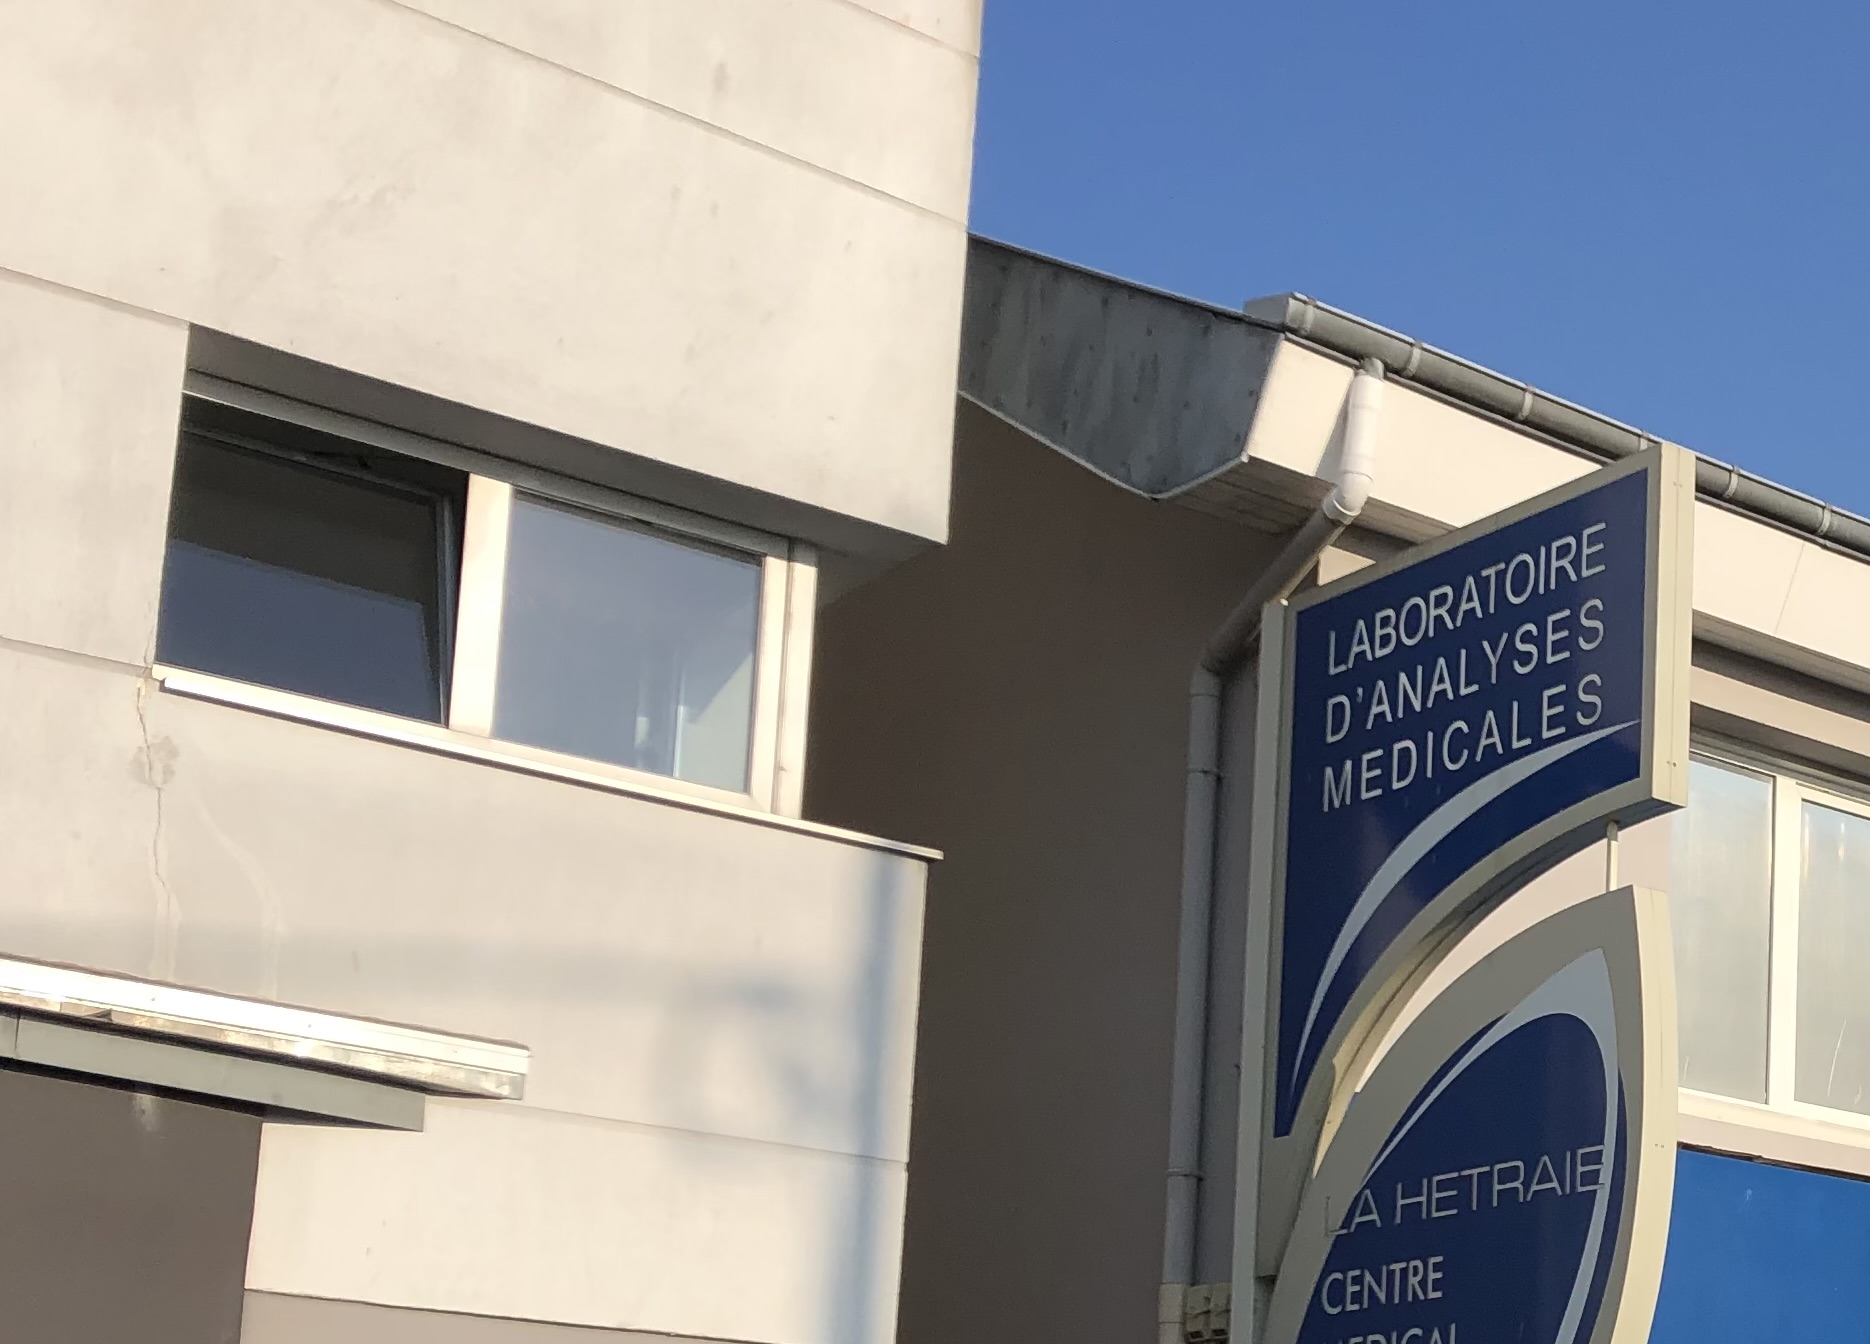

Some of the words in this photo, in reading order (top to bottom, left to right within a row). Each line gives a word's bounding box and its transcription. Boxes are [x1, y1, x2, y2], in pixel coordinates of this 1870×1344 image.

[1327, 523, 1606, 676] LABORATOIRE
[1325, 599, 1604, 744] D'ANALYSES
[1322, 674, 1603, 812] MEDICALES
[1325, 1189, 1382, 1237] LA
[1394, 1144, 1606, 1225] HETRAIE
[1321, 1256, 1444, 1315] CENTRE
